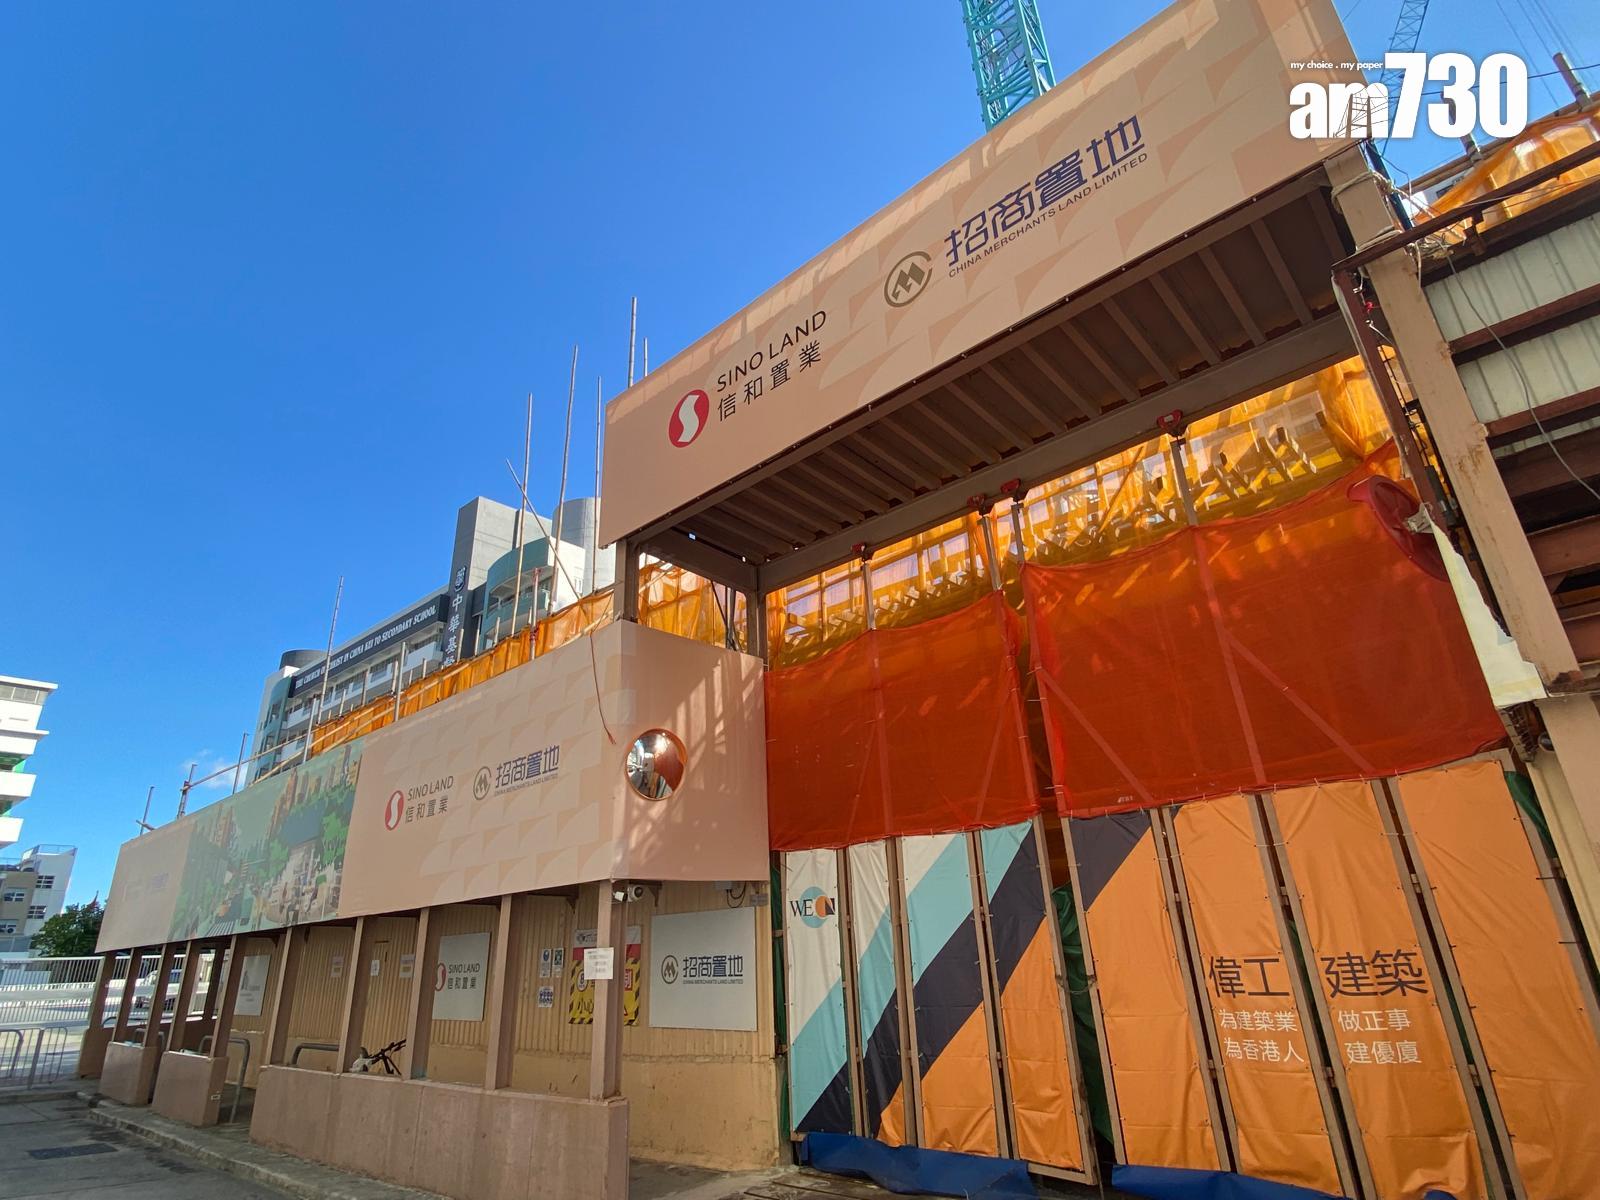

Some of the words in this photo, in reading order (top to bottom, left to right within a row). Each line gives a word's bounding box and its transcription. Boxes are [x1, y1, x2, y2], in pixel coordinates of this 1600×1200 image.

[943, 114, 1145, 267] 招商置地
[948, 253, 982, 278] CHINA
[984, 208, 1056, 258] MERCHANTS
[1058, 186, 1092, 212] LAND
[1095, 152, 1148, 190] LIMITED
[717, 351, 764, 393] SINO
[769, 310, 827, 360] LAND
[717, 339, 822, 422] 信和置業
[381, 617, 413, 642] SECONDARY
[413, 605, 437, 625] SCHOOL
[495, 744, 560, 788] 招商置地
[407, 783, 429, 801] SINO
[429, 775, 454, 794] LAND
[405, 794, 449, 824] 信和置業
[448, 964, 463, 974] SINO
[463, 962, 481, 974] LAND
[682, 955, 744, 978] 招商置地
[1208, 955, 1290, 999] 偉工
[1319, 948, 1429, 999] 建築
[1218, 1008, 1299, 1033] 為建築業
[1337, 1007, 1412, 1033] 做正事
[1223, 1037, 1305, 1064] 為香港人
[1344, 1039, 1422, 1065] 建優廈
